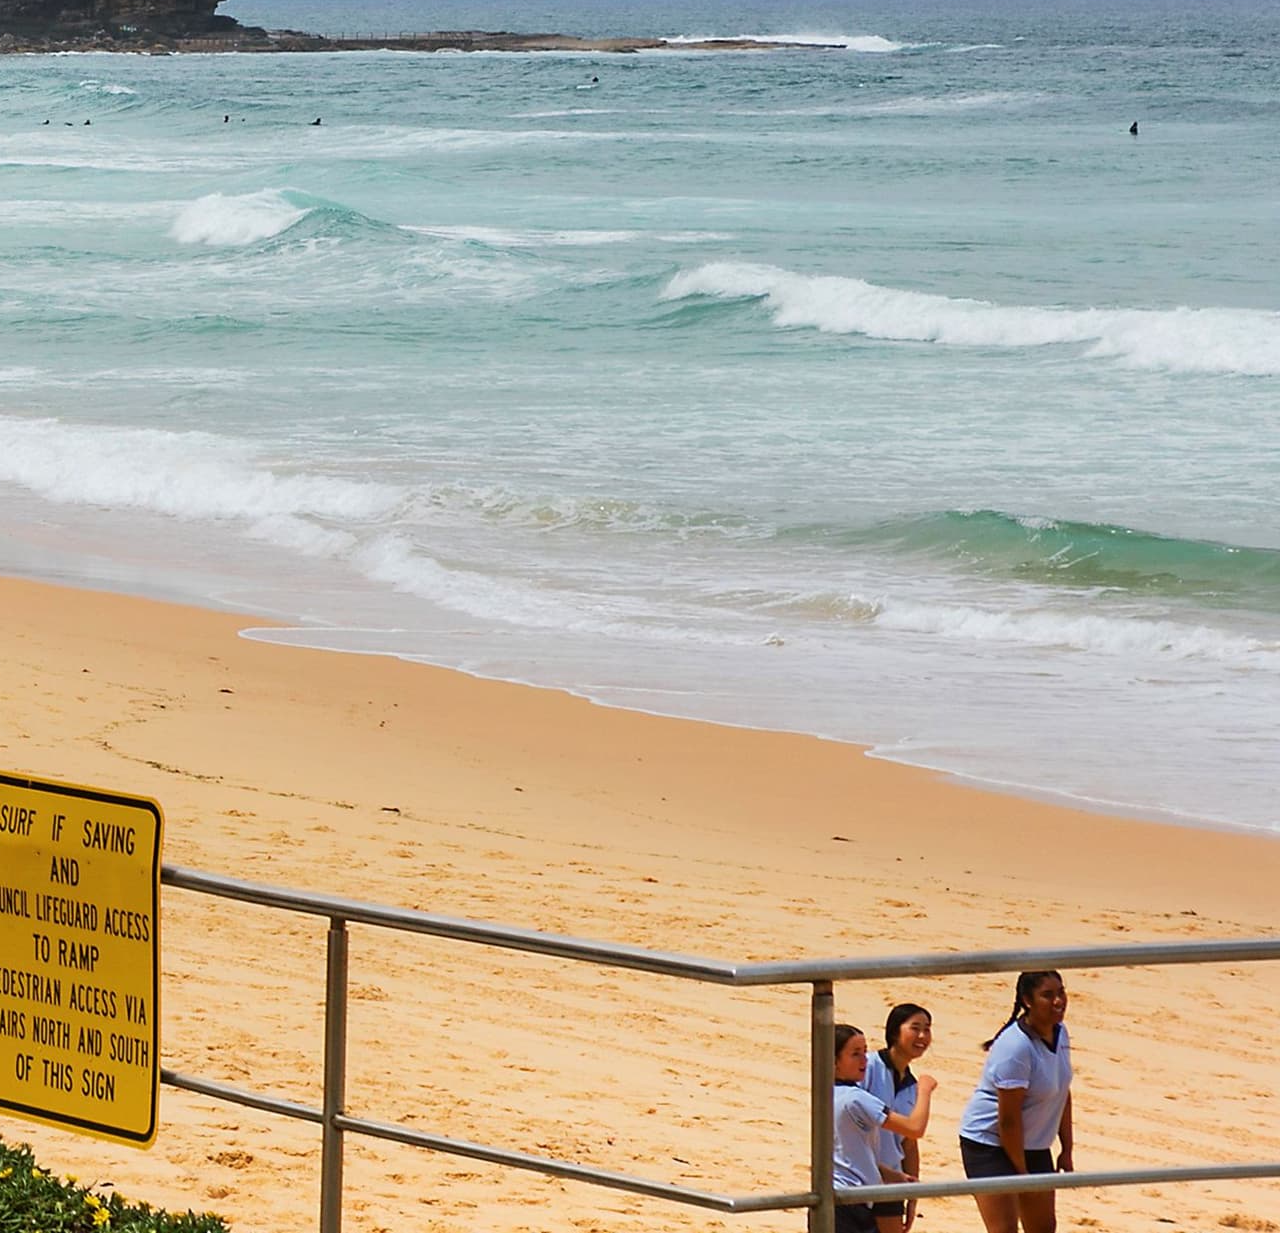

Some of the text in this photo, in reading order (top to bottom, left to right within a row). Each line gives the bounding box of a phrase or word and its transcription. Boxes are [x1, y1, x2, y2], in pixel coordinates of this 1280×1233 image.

[0, 804, 136, 856] SURF IF SAVING
[50, 855, 80, 887] AND
[36, 894, 98, 932] LIFEGUARD
[104, 907, 150, 943] ACCESS
[32, 933, 100, 973] TO RAMP
[69, 983, 117, 1020] ACCESS
[125, 994, 147, 1026] VIA
[32, 1015, 70, 1050] NORTH
[77, 1026, 103, 1058] AND
[109, 1033, 149, 1068] SOUTH
[15, 1053, 115, 1103] OF THIS SIGN
